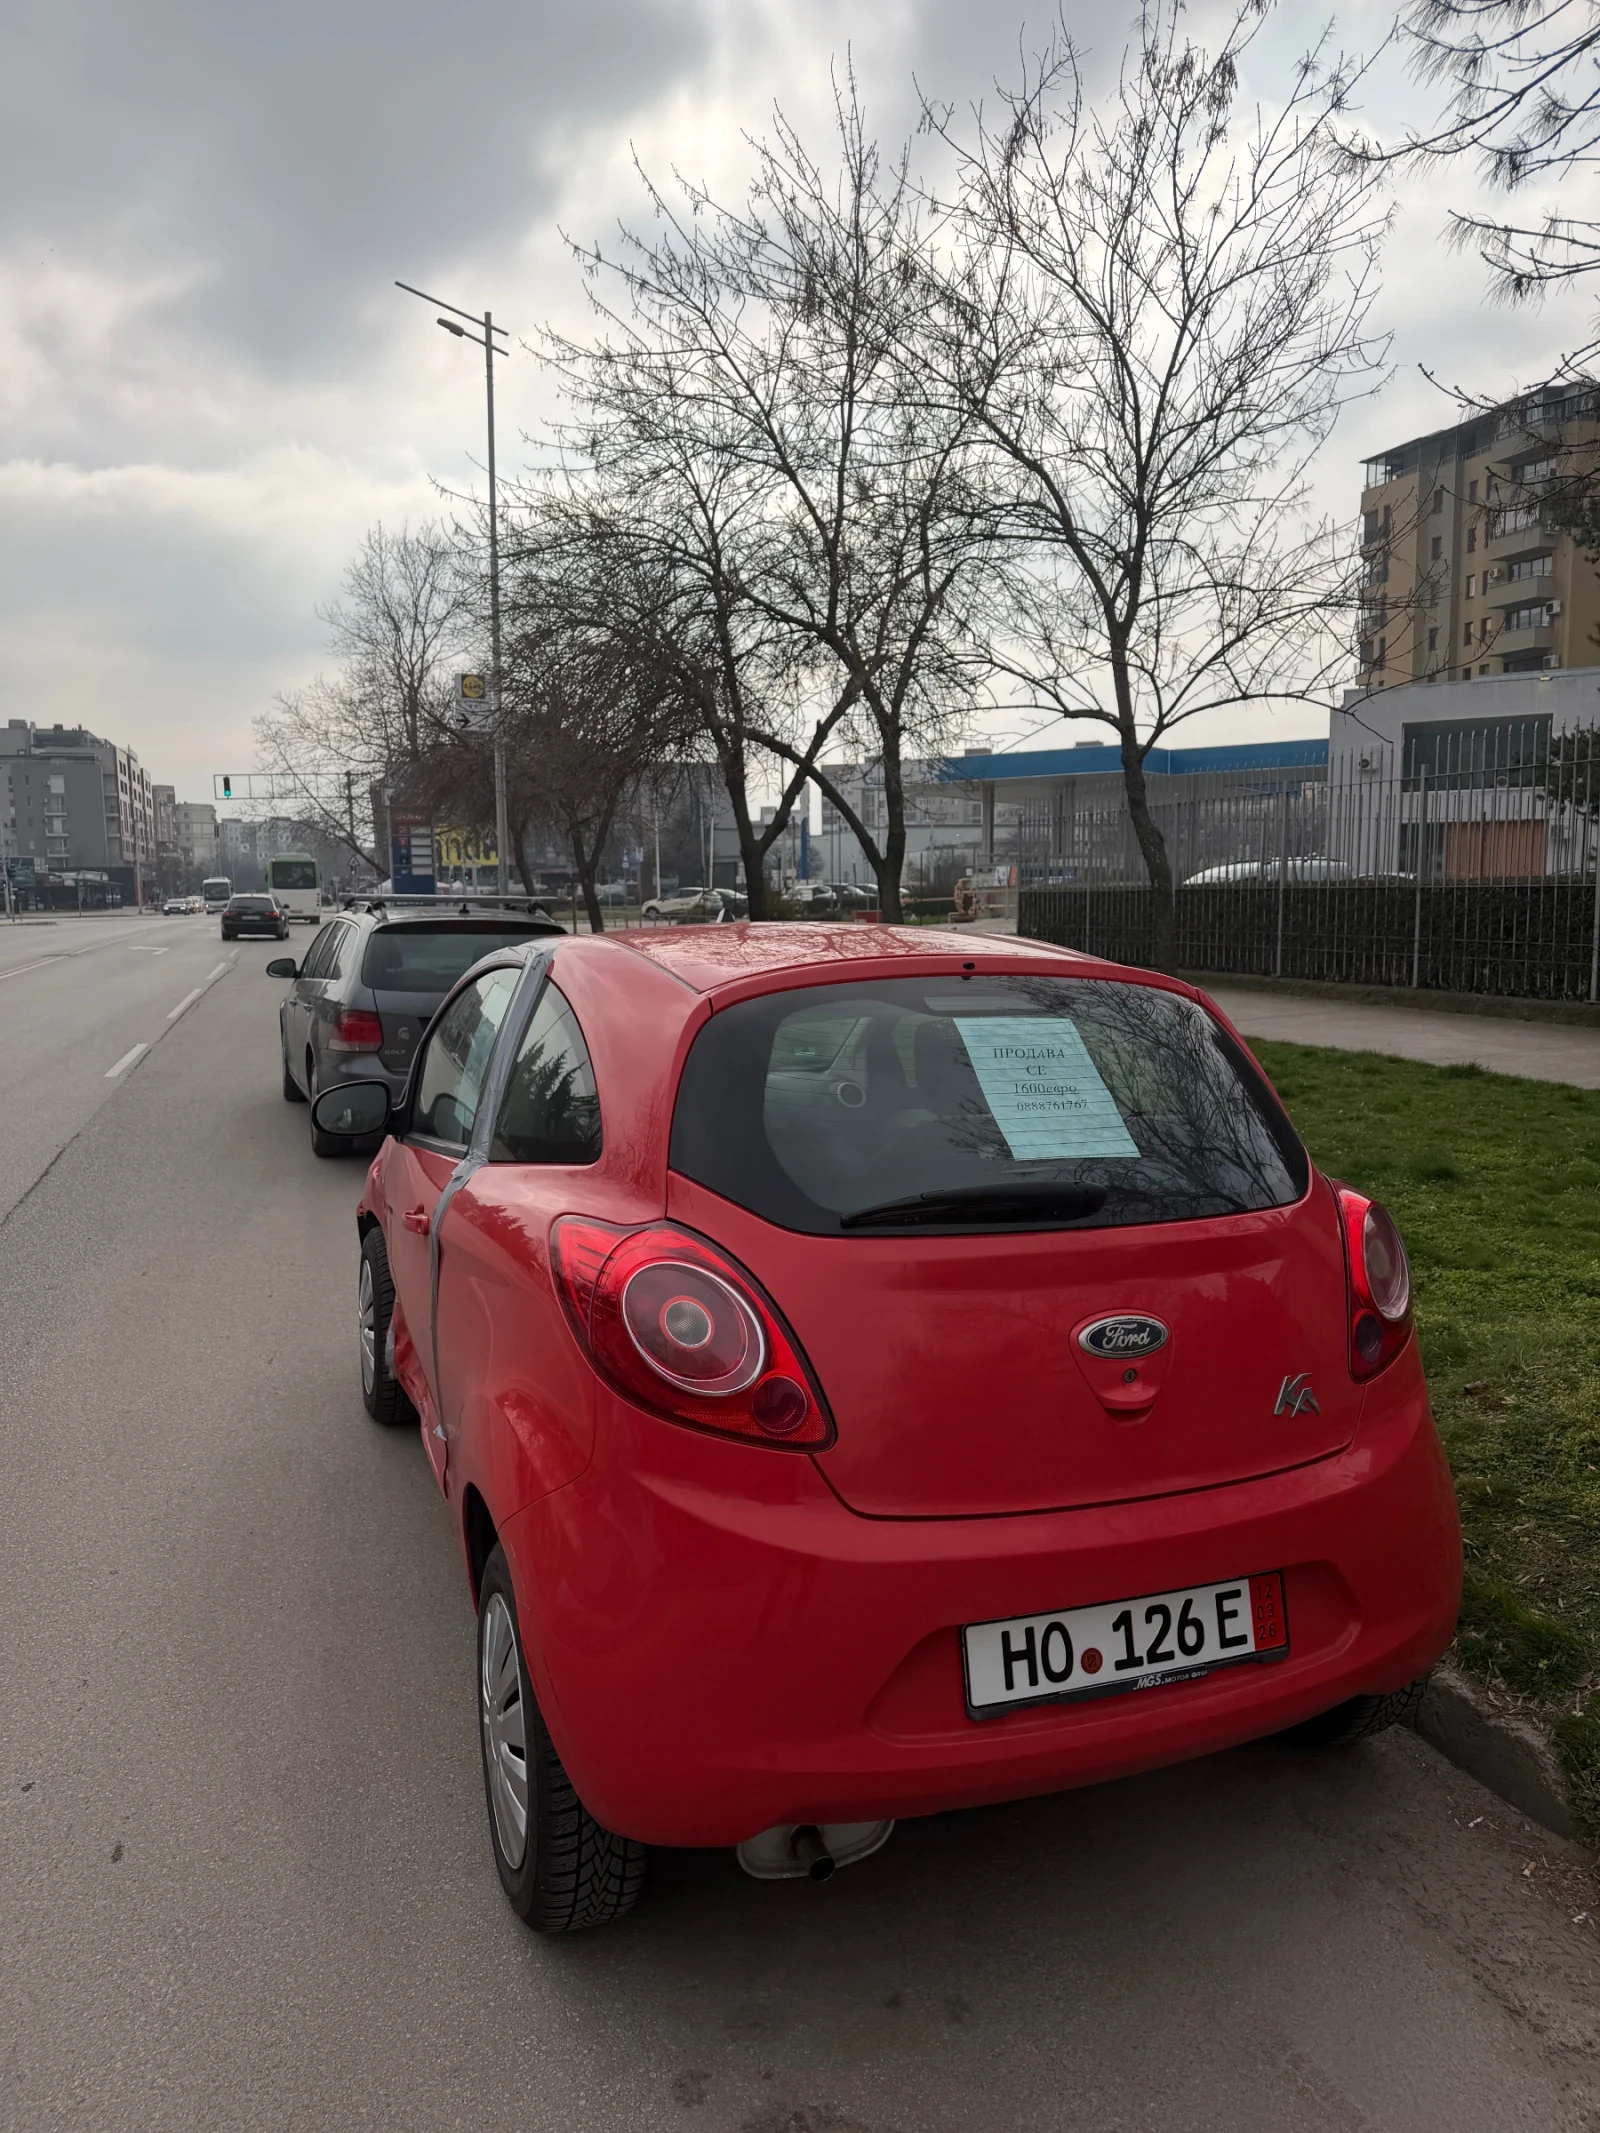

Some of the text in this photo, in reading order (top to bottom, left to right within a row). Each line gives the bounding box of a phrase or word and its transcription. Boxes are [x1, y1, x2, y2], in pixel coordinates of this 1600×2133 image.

[993, 1047, 1065, 1060] ПРОДАВА
[1026, 1064, 1047, 1076] СЕ
[1014, 1082, 1078, 1096] 1600евро
[1017, 1099, 1087, 1111] 0888761767
[1102, 1323, 1150, 1349] Ford
[1255, 1582, 1273, 1600] 12
[1256, 1602, 1275, 1621] 03
[1258, 1622, 1277, 1641] 26
[1000, 1621, 1074, 1691] HO
